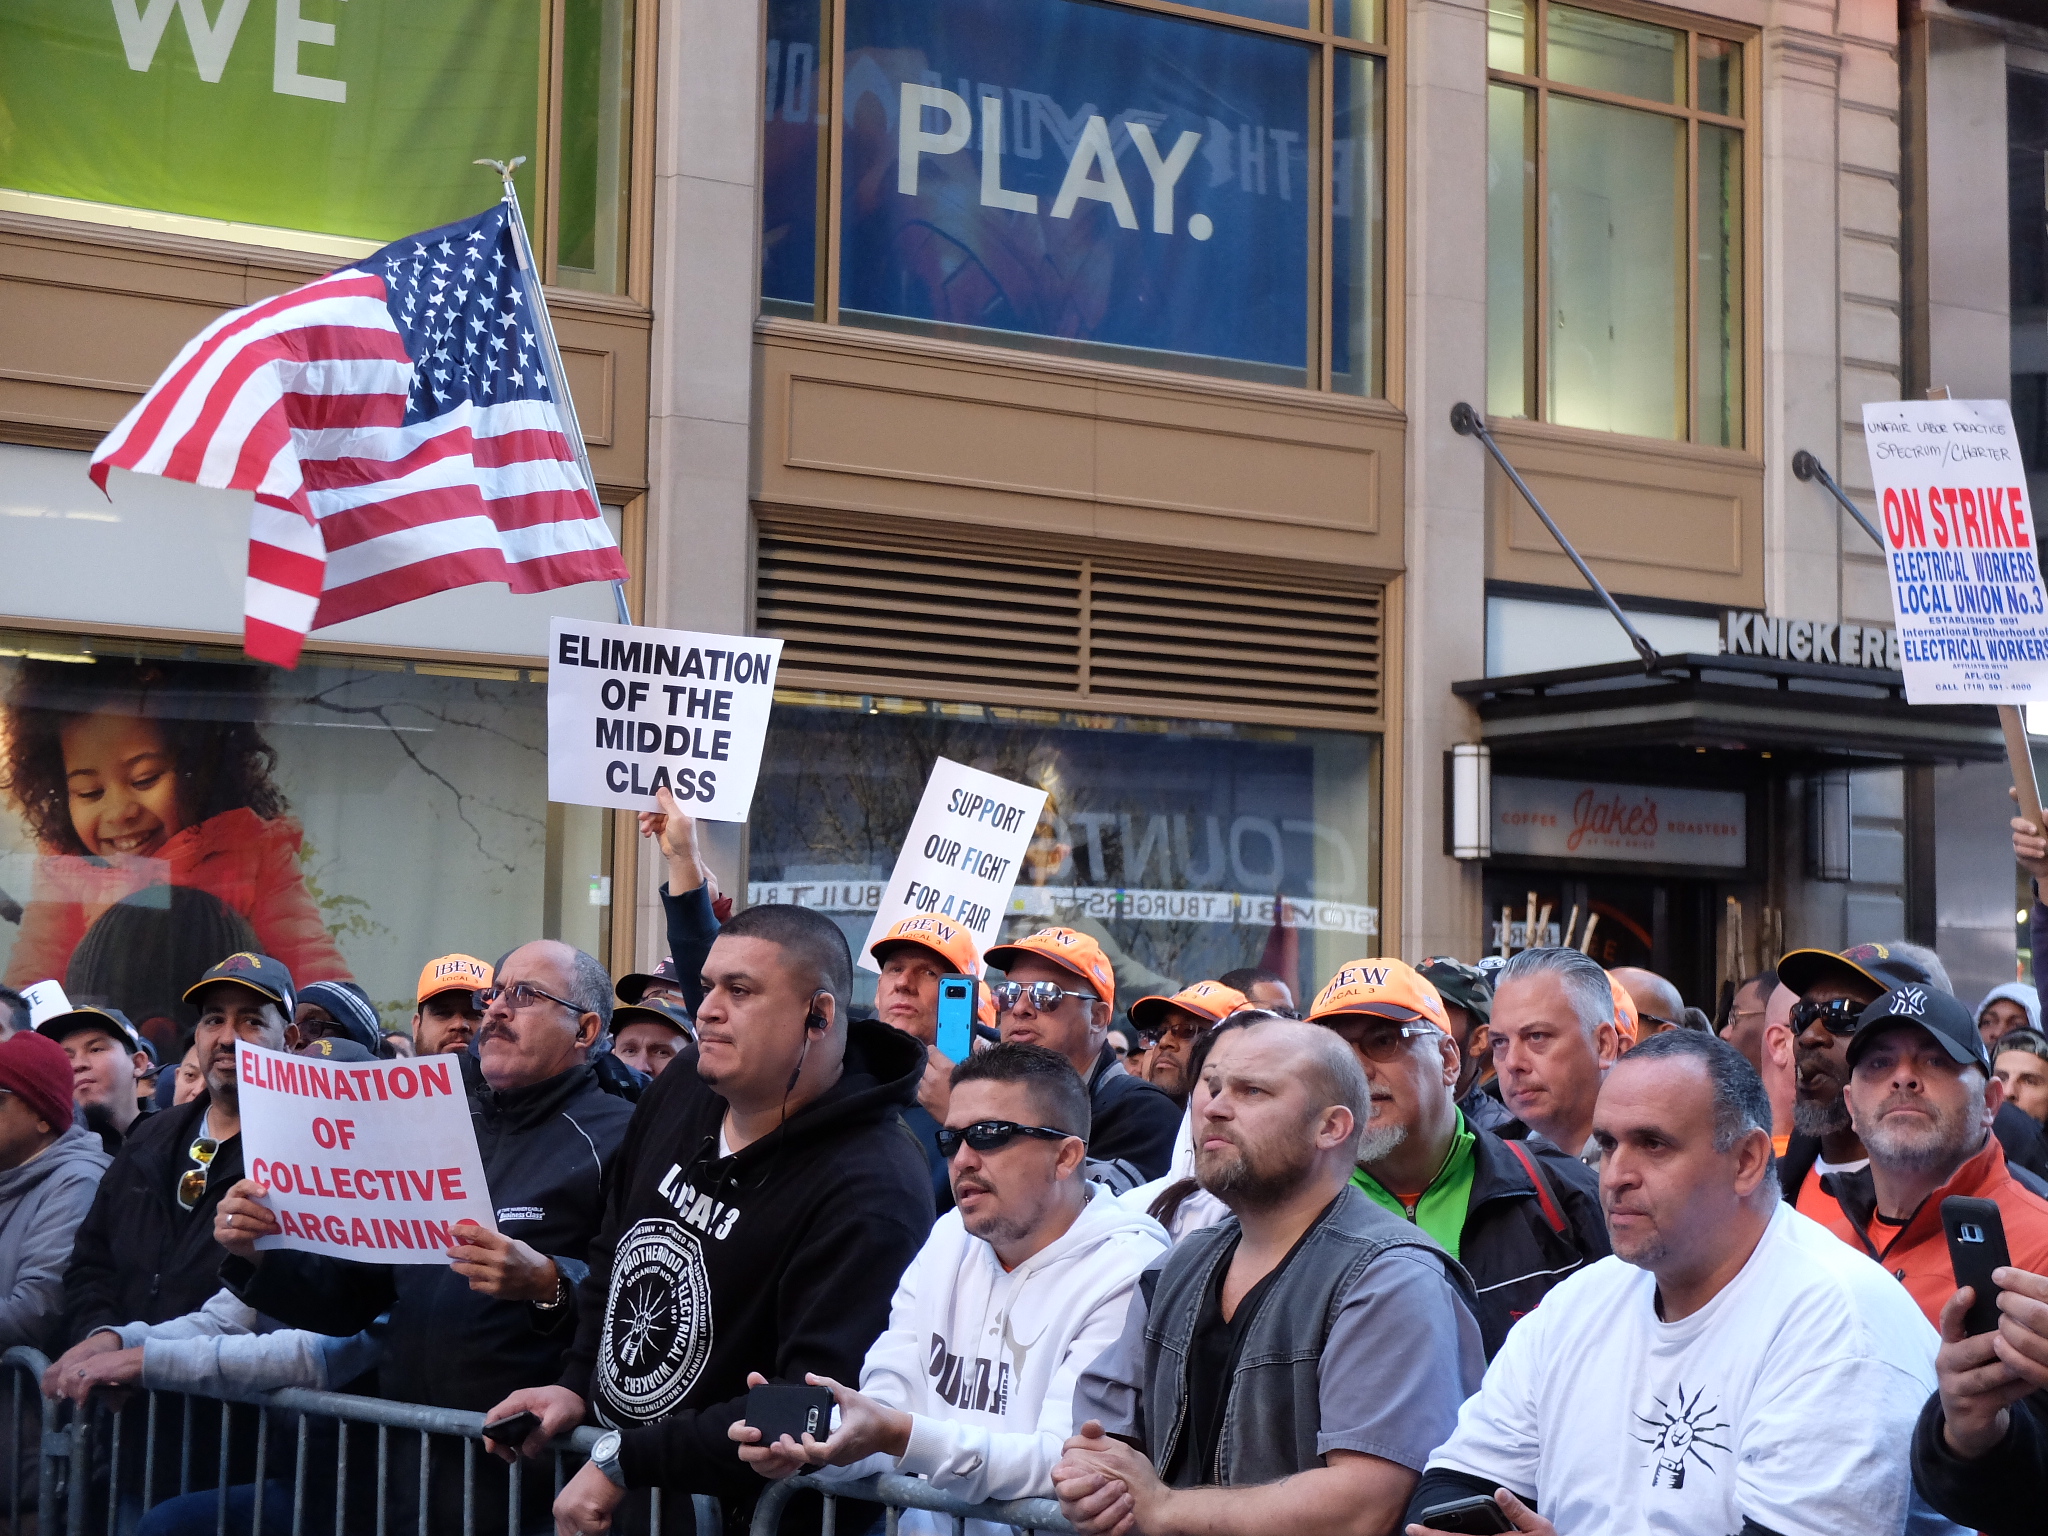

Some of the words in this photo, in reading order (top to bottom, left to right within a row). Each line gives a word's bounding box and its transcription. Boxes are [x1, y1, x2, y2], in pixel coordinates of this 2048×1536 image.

[112, 0, 347, 103] WE
[898, 82, 1213, 241] PLAY.
[1867, 421, 1910, 434] UNFAIR
[1917, 421, 1948, 434] LABOR
[1953, 422, 2006, 436] PRACTICE
[1883, 487, 1926, 549] ON
[1928, 486, 2030, 549] STRIKE
[1893, 551, 1969, 583] ELECTRICAL
[1972, 551, 2036, 583] WORKERS
[1898, 584, 1951, 614] LOCAL
[1953, 584, 2004, 614] UNION
[2005, 585, 2044, 615] No.3
[1902, 627, 1970, 638] International
[1972, 627, 2037, 637] Brotherhood
[1929, 616, 1995, 625] ESTABLISHED
[1999, 617, 2019, 625] 1891
[559, 633, 772, 685] ELIMINATION
[1904, 638, 1986, 662] ELECTRICAL
[1986, 639, 2048, 662] WORKERS
[1964, 672, 2000, 680] AFL-CIO
[601, 678, 650, 712] OF
[662, 684, 734, 722] THE
[595, 717, 732, 762] MIDDLE
[605, 760, 717, 803] CLASS
[947, 788, 1026, 834] SUPPORT
[1501, 812, 1557, 828] COFFEE
[1567, 788, 1658, 851] Jake's
[1667, 820, 1737, 836] ROASTERS
[923, 834, 961, 867] OUR
[961, 846, 1011, 883] FIGHT
[903, 881, 941, 913] FOR
[941, 894, 955, 916] A
[955, 899, 991, 933] FAIR
[898, 919, 956, 942] IBEW
[435, 960, 486, 979] IBEW
[1325, 988, 1361, 1008] LOCAL
[242, 1049, 453, 1102] ELIMINATION
[312, 1117, 356, 1150] OF
[253, 1157, 467, 1201] COLLECTIVE
[714, 1207, 740, 1241] 3
[694, 1262, 707, 1302] CONGRESS
[605, 1275, 625, 1382] INTERNATIONAL
[667, 1281, 692, 1362] ELECTRICAL
[699, 1304, 707, 1337] LABOUR
[624, 1361, 674, 1393] WORKERS
[686, 1339, 706, 1379] CANADIAN
[633, 1384, 683, 1414] ORGANIZATIONS
[681, 1378, 689, 1387] &
